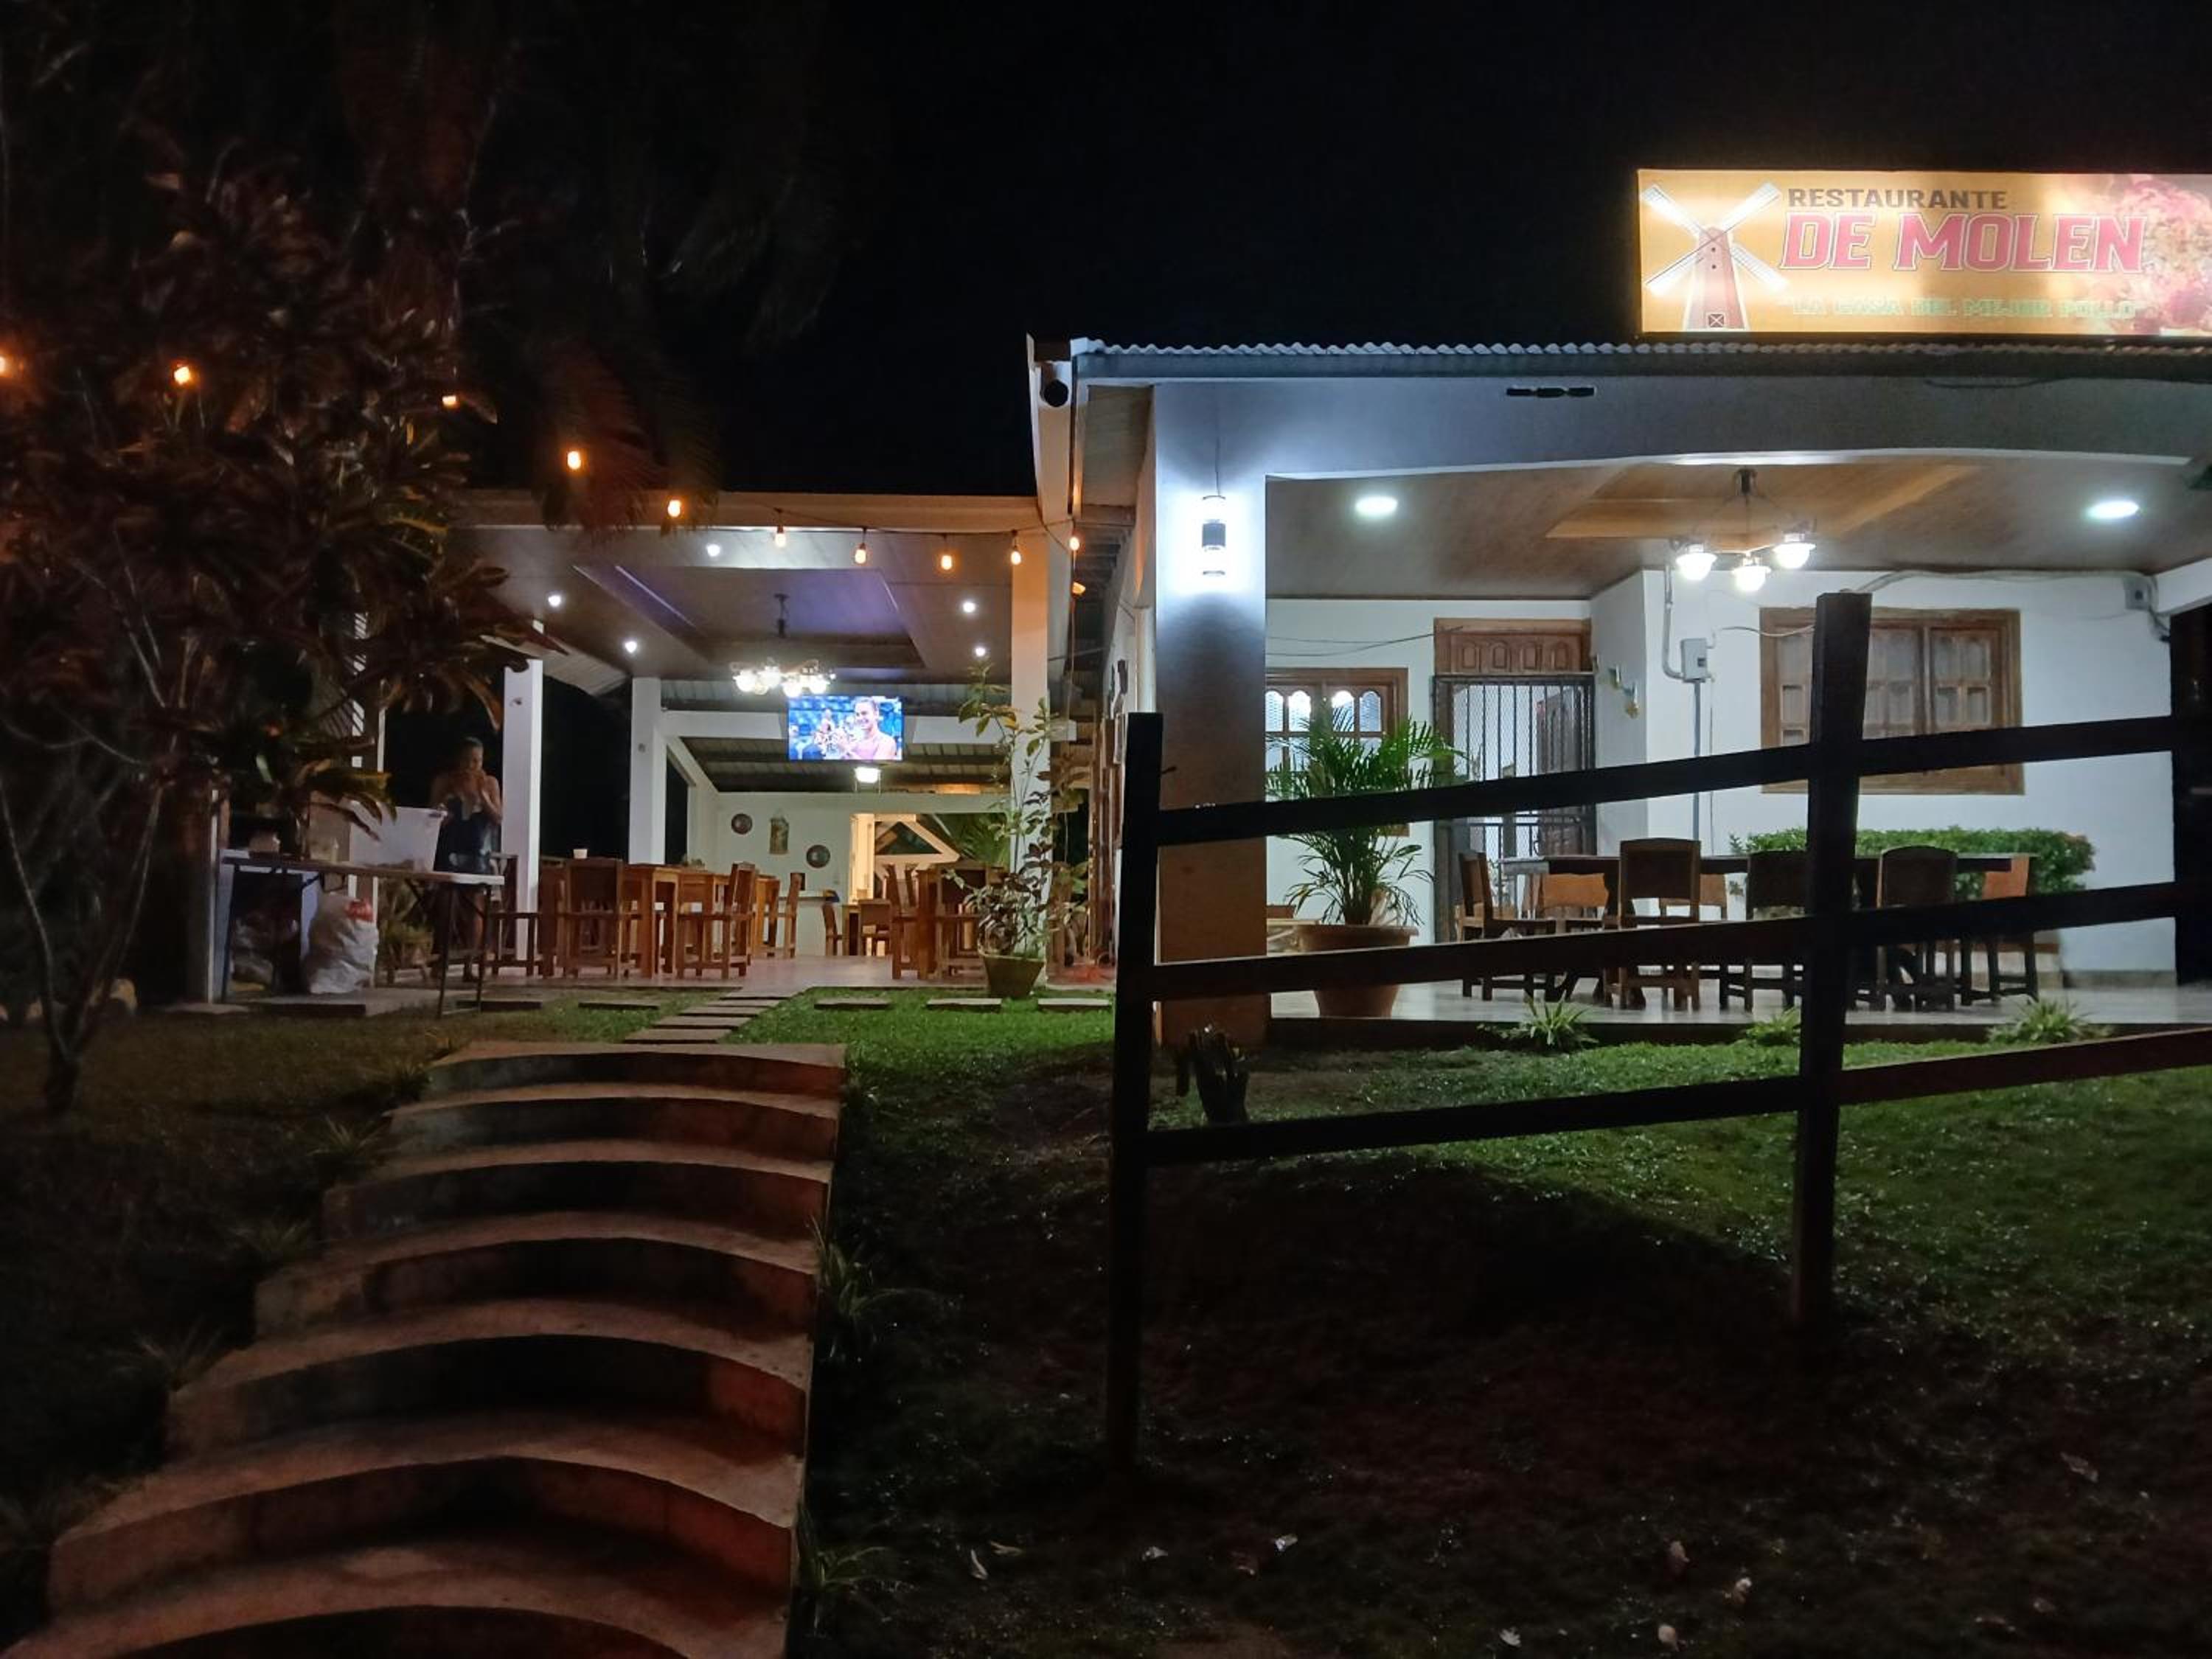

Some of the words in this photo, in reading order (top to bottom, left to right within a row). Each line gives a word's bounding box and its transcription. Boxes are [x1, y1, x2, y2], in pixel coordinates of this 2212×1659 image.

[1788, 189, 2007, 209] RESTAURANTE
[1780, 212, 1877, 271] DE
[1893, 213, 2147, 273] MOLEN
